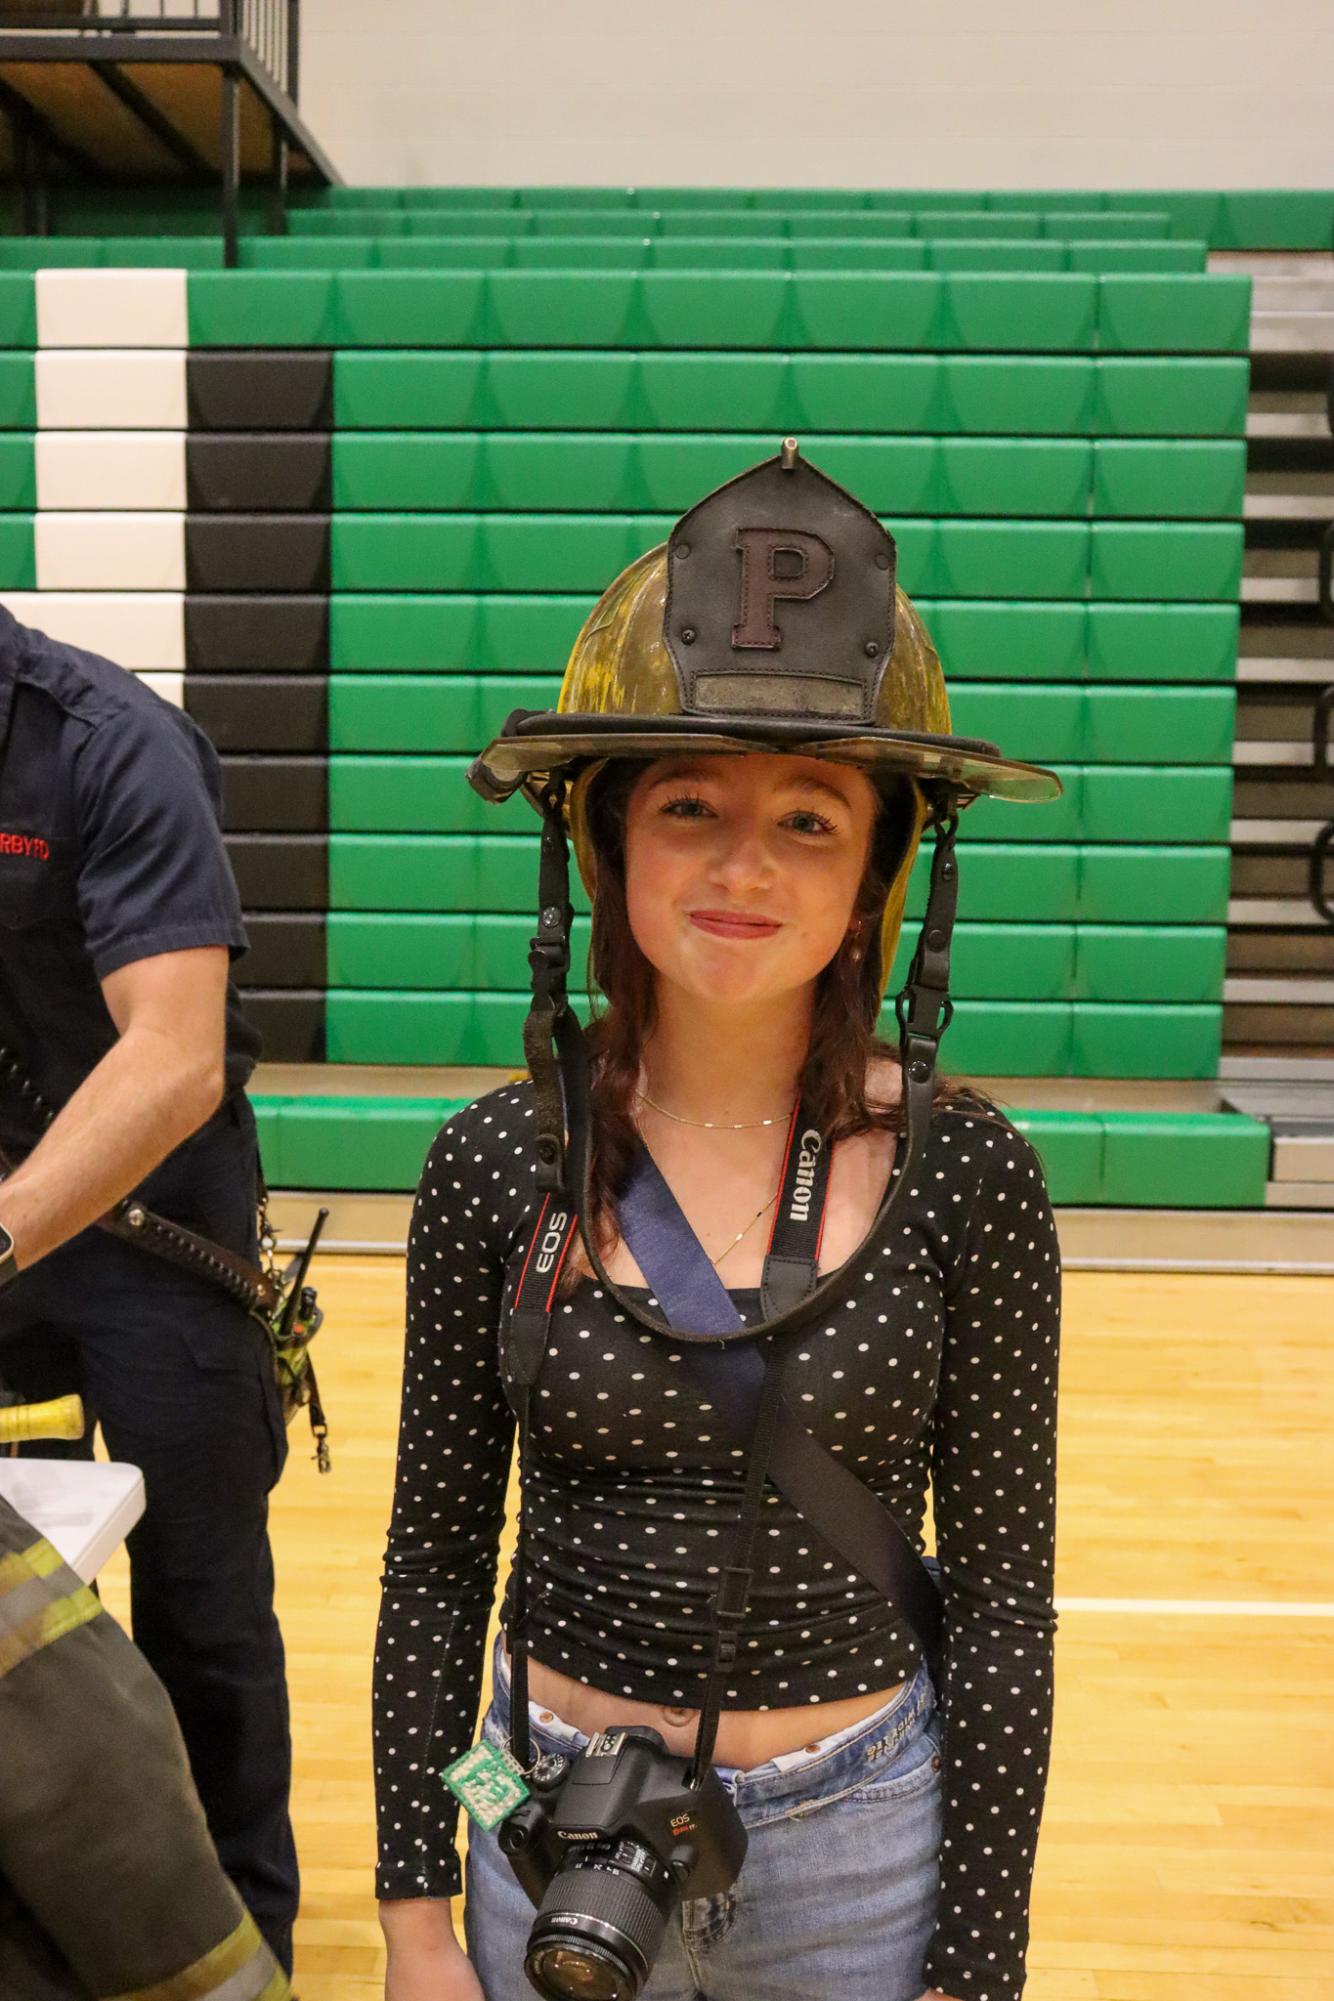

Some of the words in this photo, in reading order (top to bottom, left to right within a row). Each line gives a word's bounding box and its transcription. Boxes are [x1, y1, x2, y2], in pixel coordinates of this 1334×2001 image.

[731, 527, 835, 649] P
[789, 1129, 821, 1222] Canon
[536, 1211, 567, 1273] EOS
[557, 1830, 599, 1841] Canon
[670, 1813, 690, 1827] EOS
